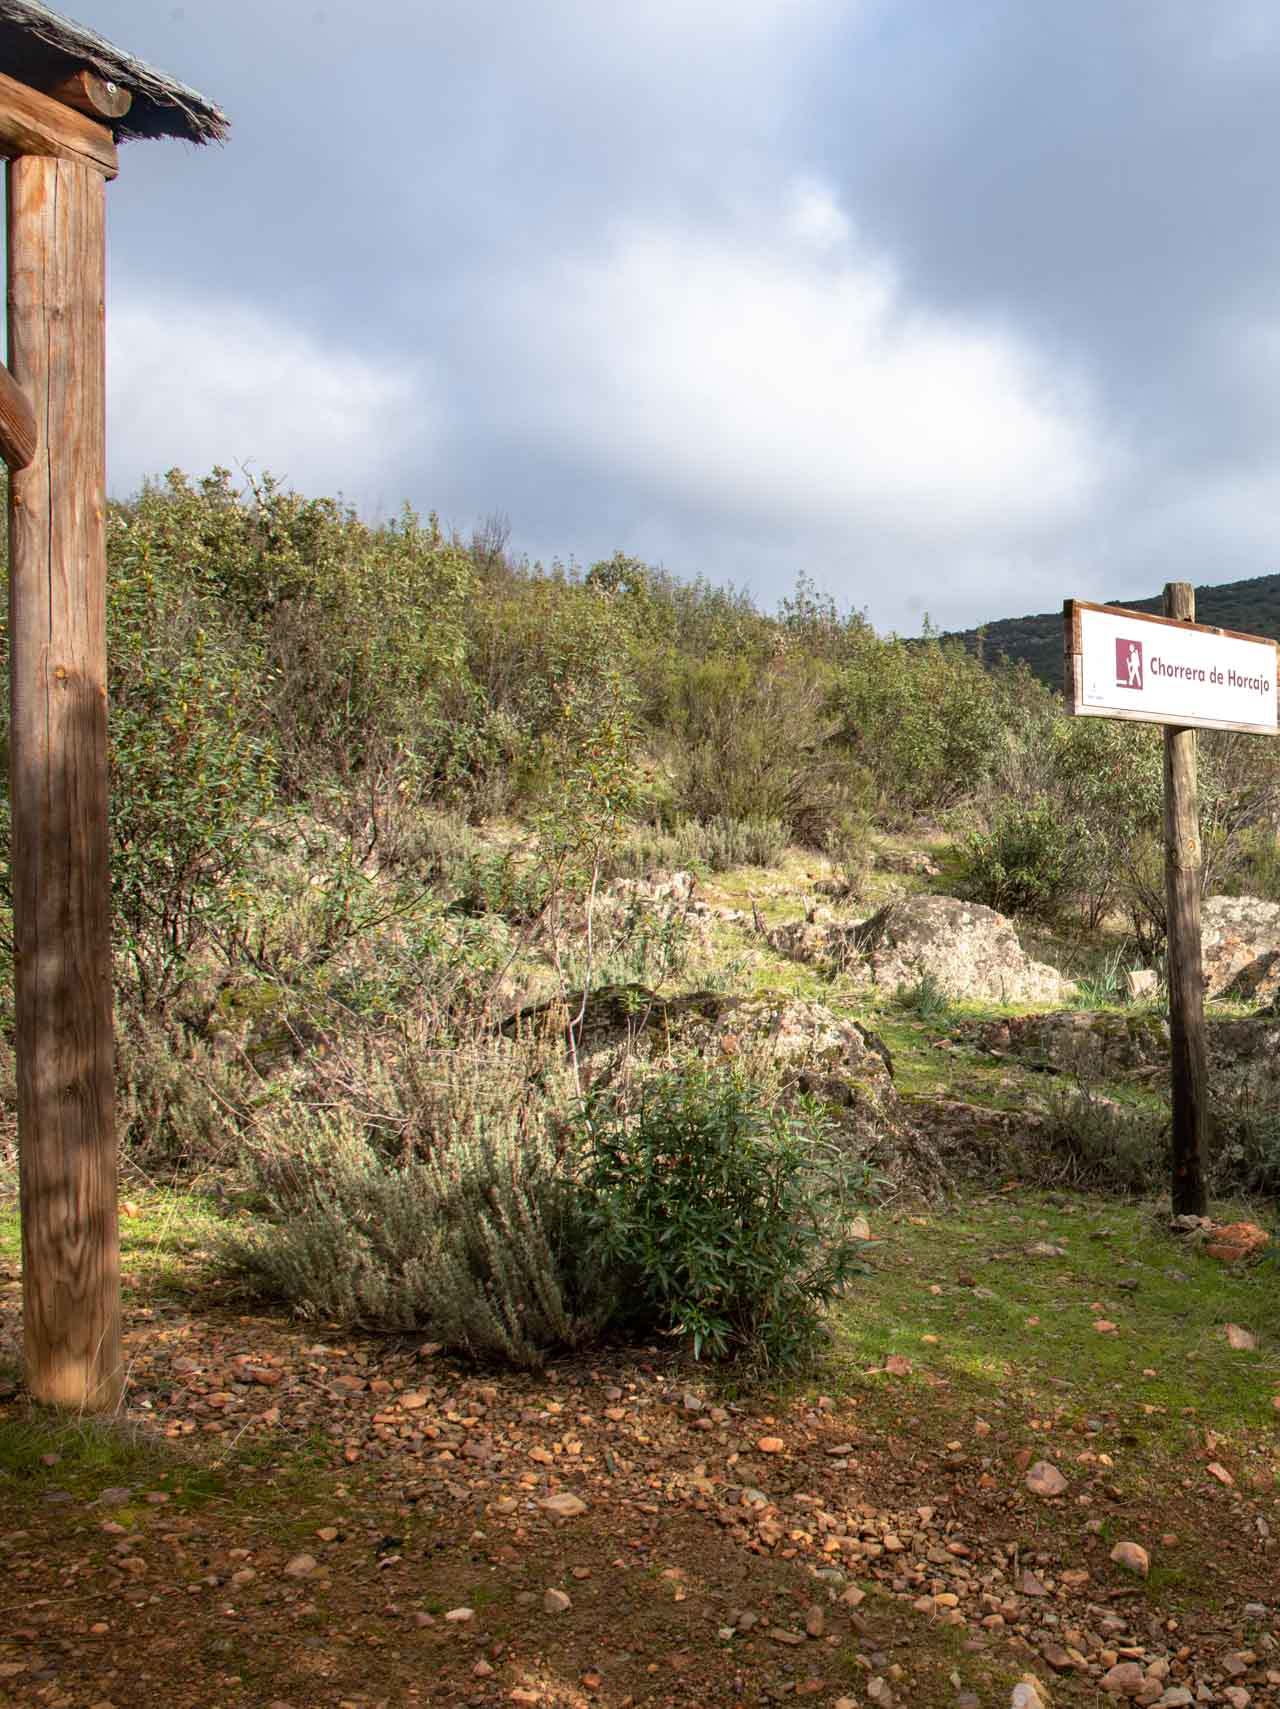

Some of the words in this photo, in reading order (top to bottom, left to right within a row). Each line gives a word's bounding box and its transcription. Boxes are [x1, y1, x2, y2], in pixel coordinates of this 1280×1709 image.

[1150, 656, 1205, 682] Chorrera
[1209, 666, 1224, 685] de
[1228, 668, 1270, 696] Horcajo
